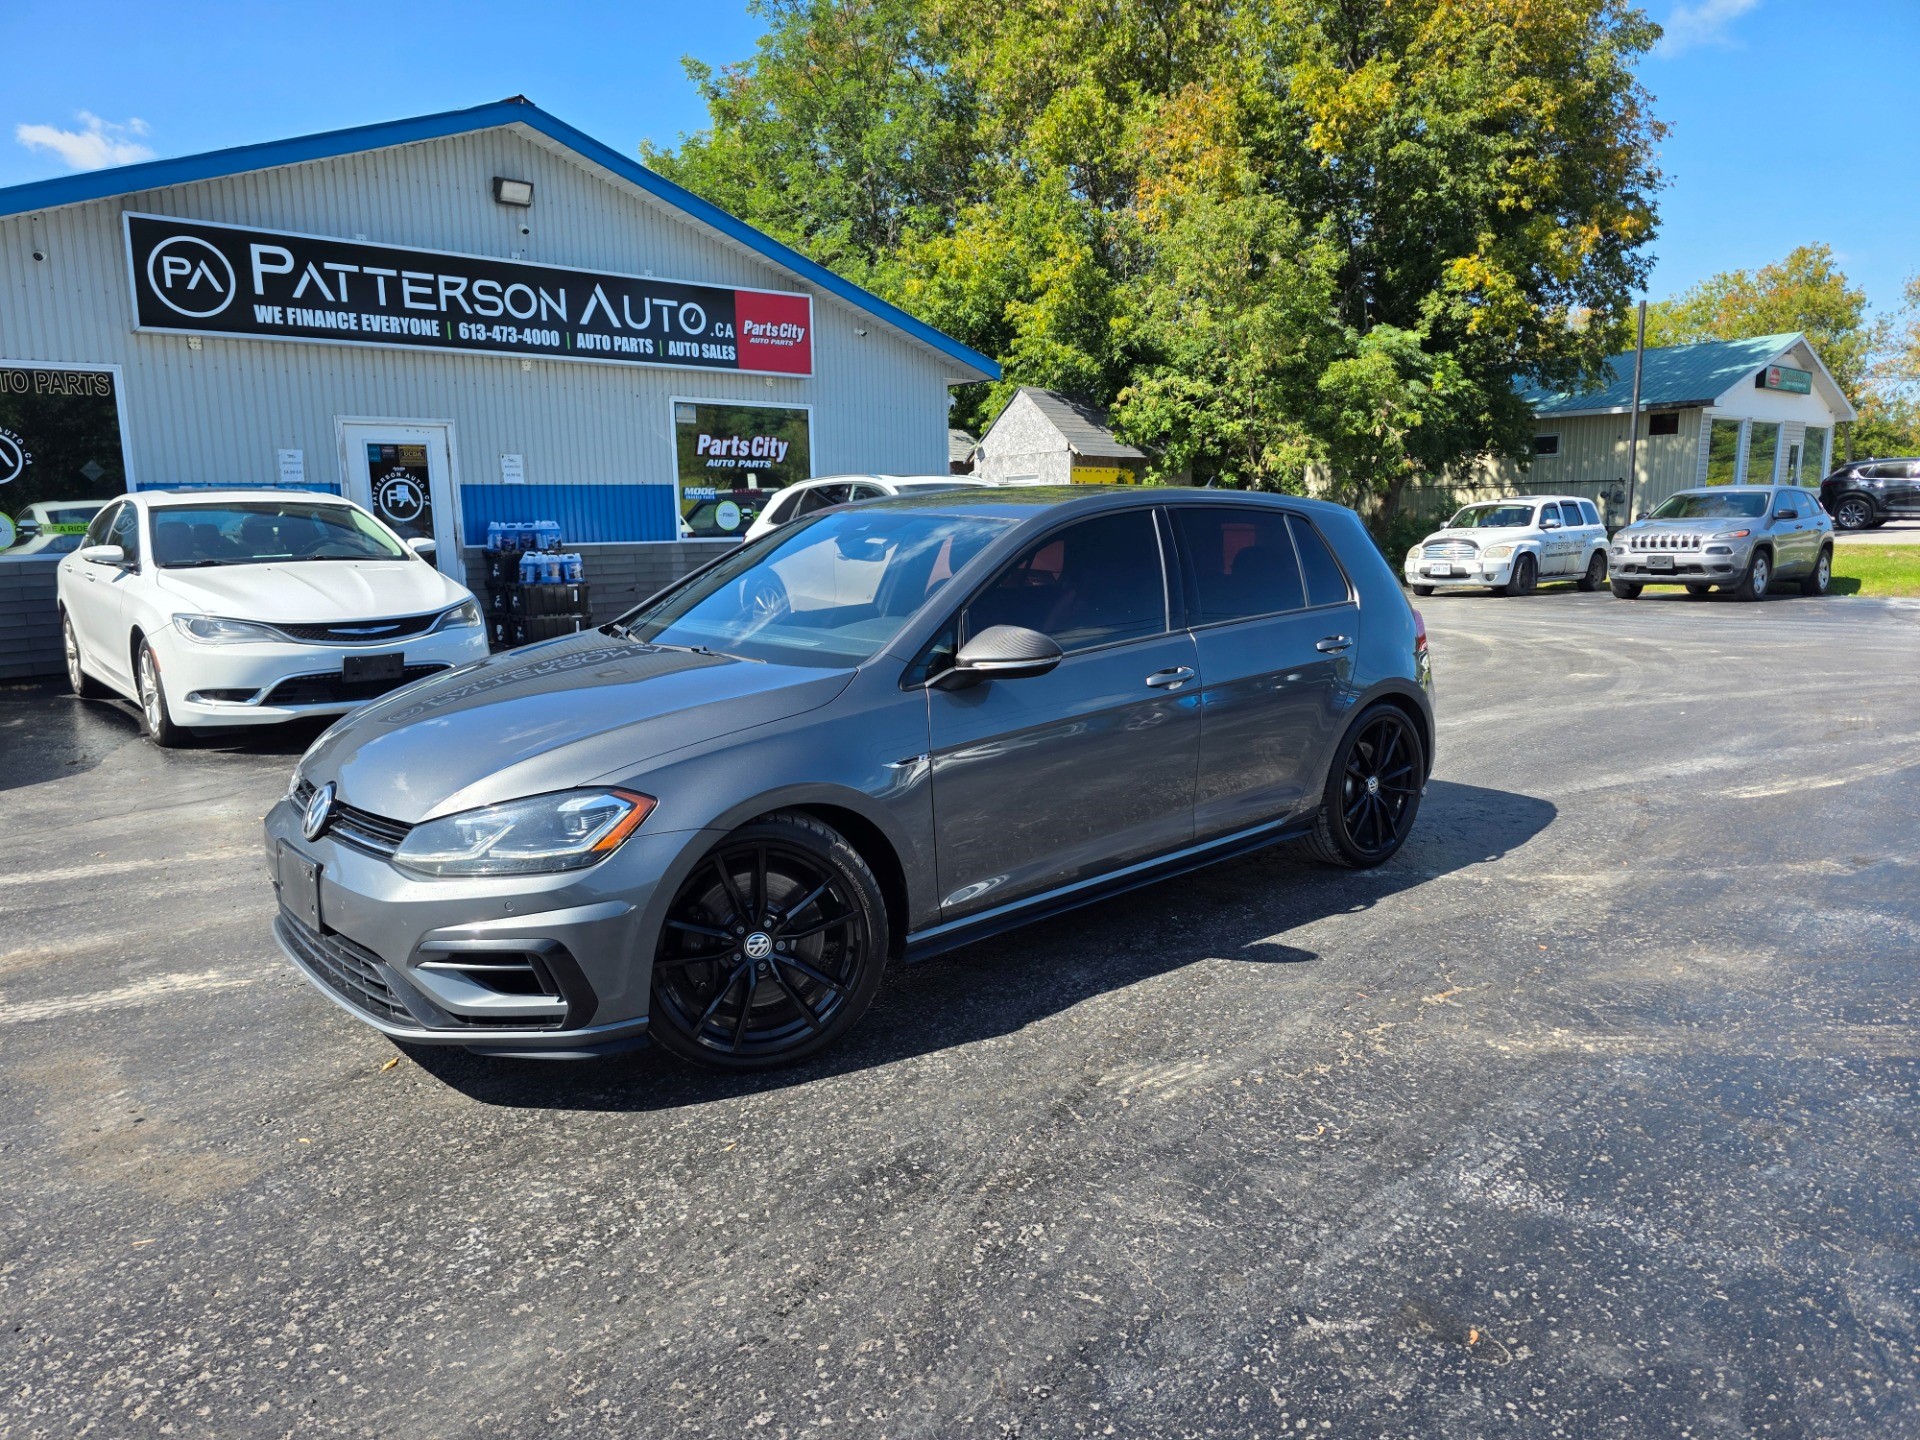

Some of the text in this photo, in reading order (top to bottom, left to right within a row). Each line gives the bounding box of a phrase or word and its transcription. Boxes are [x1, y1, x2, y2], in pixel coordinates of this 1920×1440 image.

[162, 256, 224, 293] PA
[250, 243, 568, 322] PATTERSON
[579, 283, 706, 335] AUTO
[253, 304, 440, 337] WE FINANCE EVERYONE
[458, 322, 560, 347] 613-473-4000
[577, 332, 654, 354] AUTO PARTS
[750, 337, 794, 347] AUTO PARTS
[668, 341, 736, 361] AUTO SALES
[33, 370, 111, 397] PARTS
[706, 459, 772, 469] AUTO PARTS
[373, 472, 401, 506] PATTERSON
[405, 473, 425, 489] AUTO
[684, 487, 716, 495] MOOG
